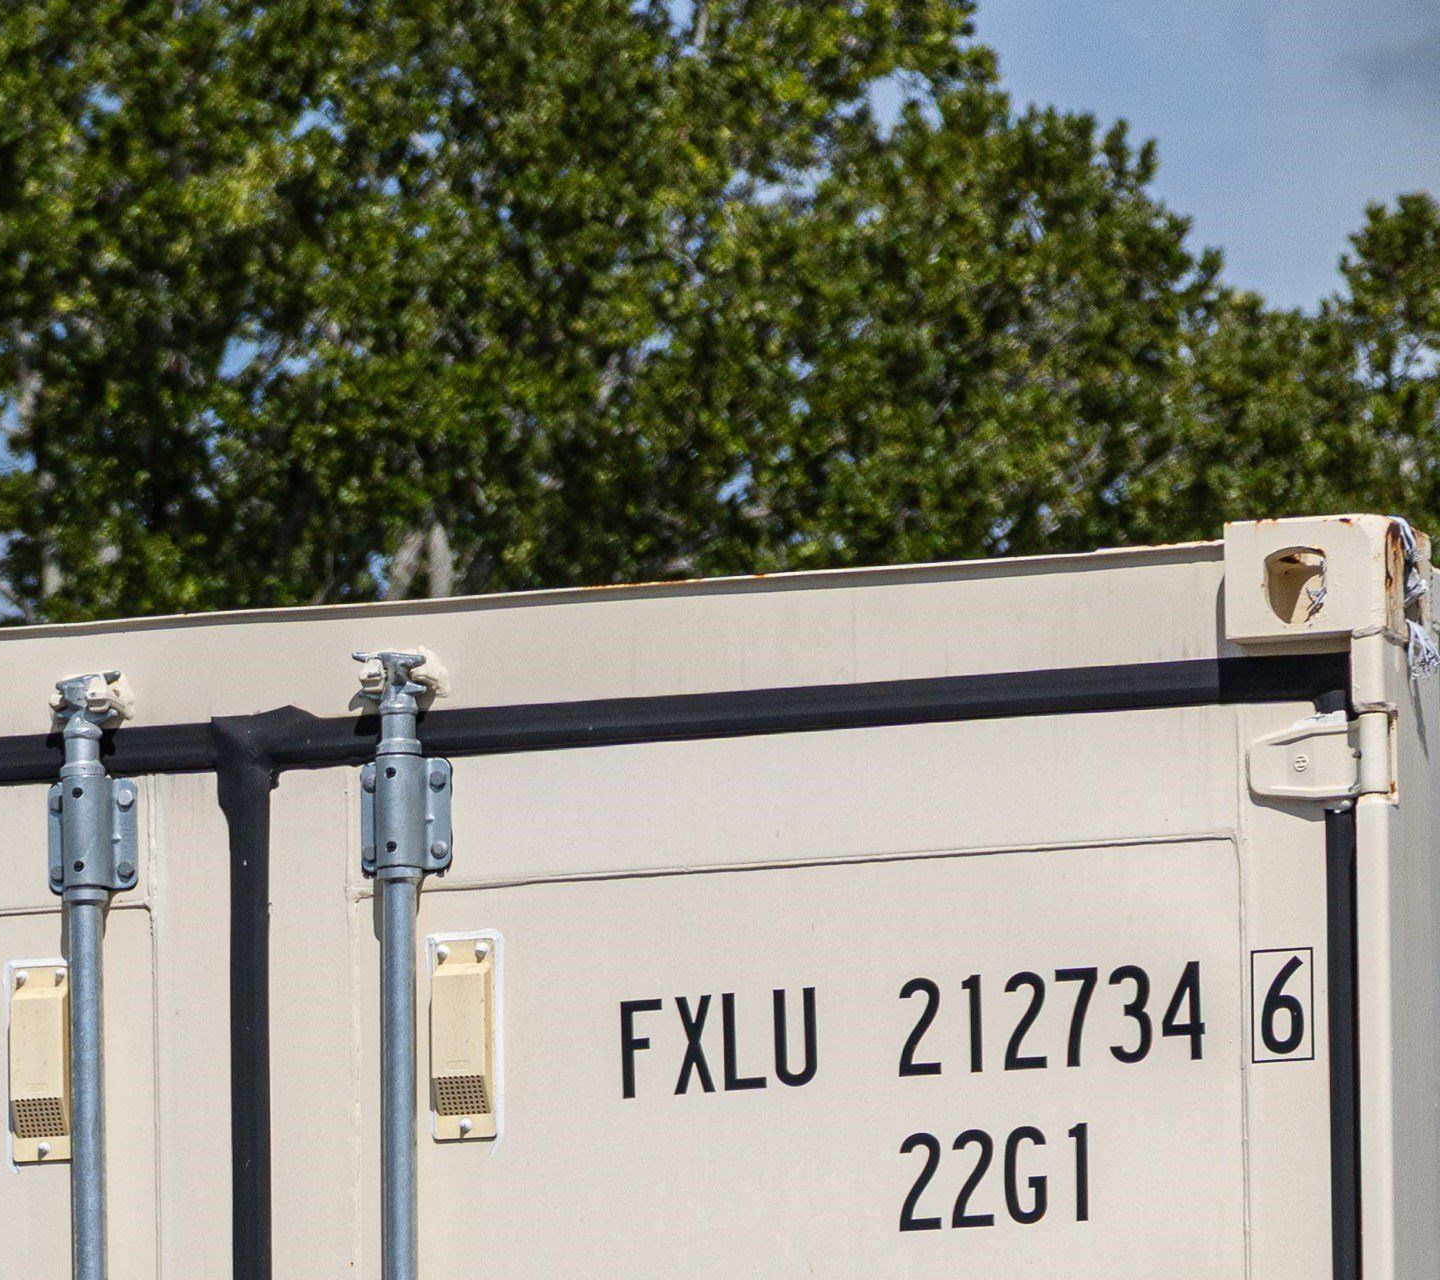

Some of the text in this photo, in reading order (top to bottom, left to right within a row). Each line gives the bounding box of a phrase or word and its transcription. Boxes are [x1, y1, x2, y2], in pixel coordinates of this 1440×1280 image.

[620, 954, 1305, 1099] FXLU 212734 6
[899, 1122, 1088, 1232] 22G1
